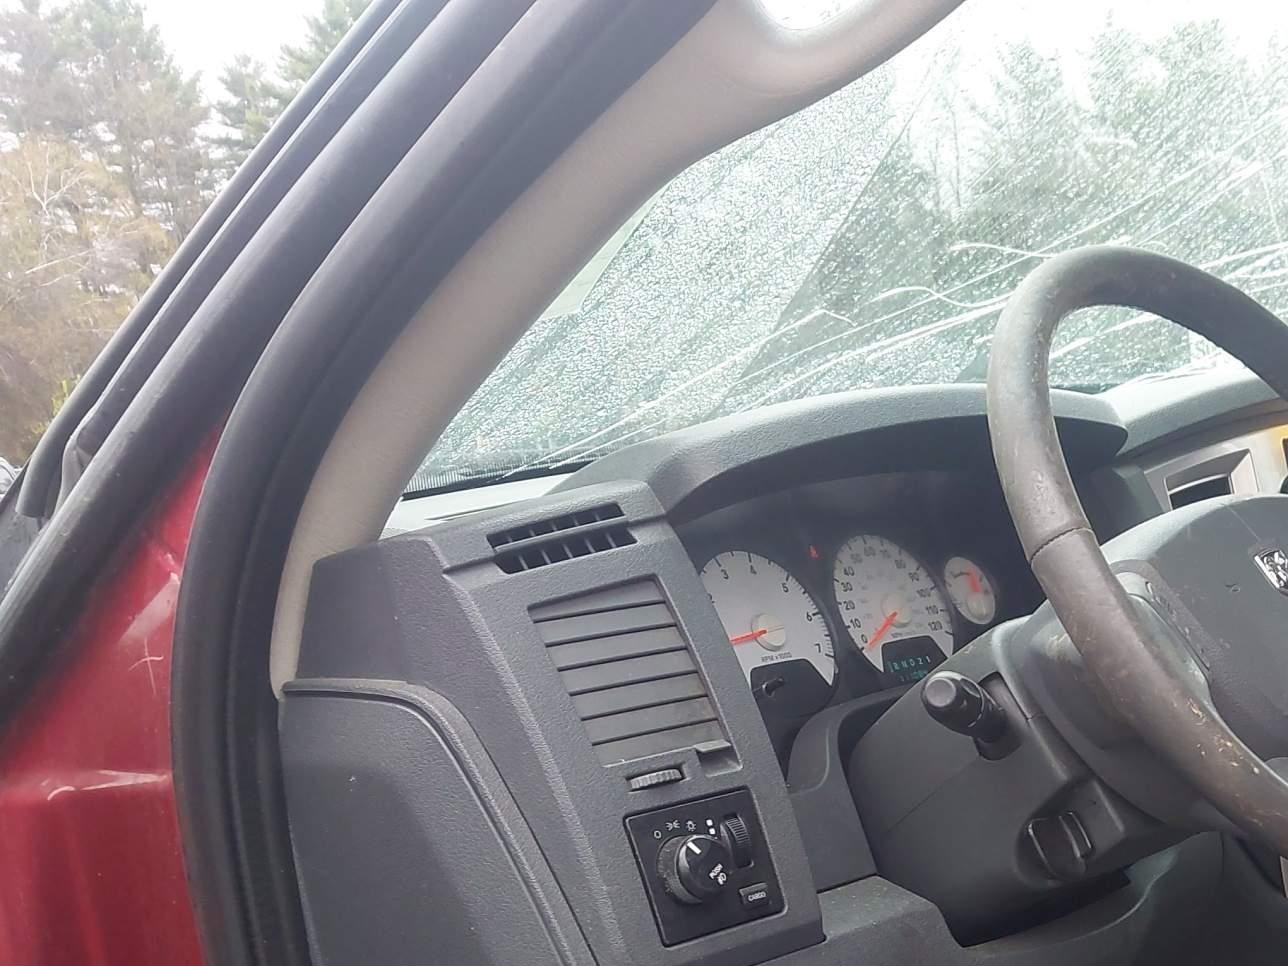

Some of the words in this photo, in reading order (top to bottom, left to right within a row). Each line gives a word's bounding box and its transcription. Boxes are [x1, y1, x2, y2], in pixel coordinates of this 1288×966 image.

[720, 569, 729, 580] 3
[750, 564, 757, 575] 4
[843, 566, 855, 577] 40
[781, 582, 789, 593] 5
[841, 582, 853, 592] 30
[843, 600, 855, 611] 20
[806, 612, 813, 622] 6
[850, 618, 861, 629] 10
[928, 620, 943, 631] 120
[861, 634, 868, 644] 0
[814, 643, 821, 653] 7
